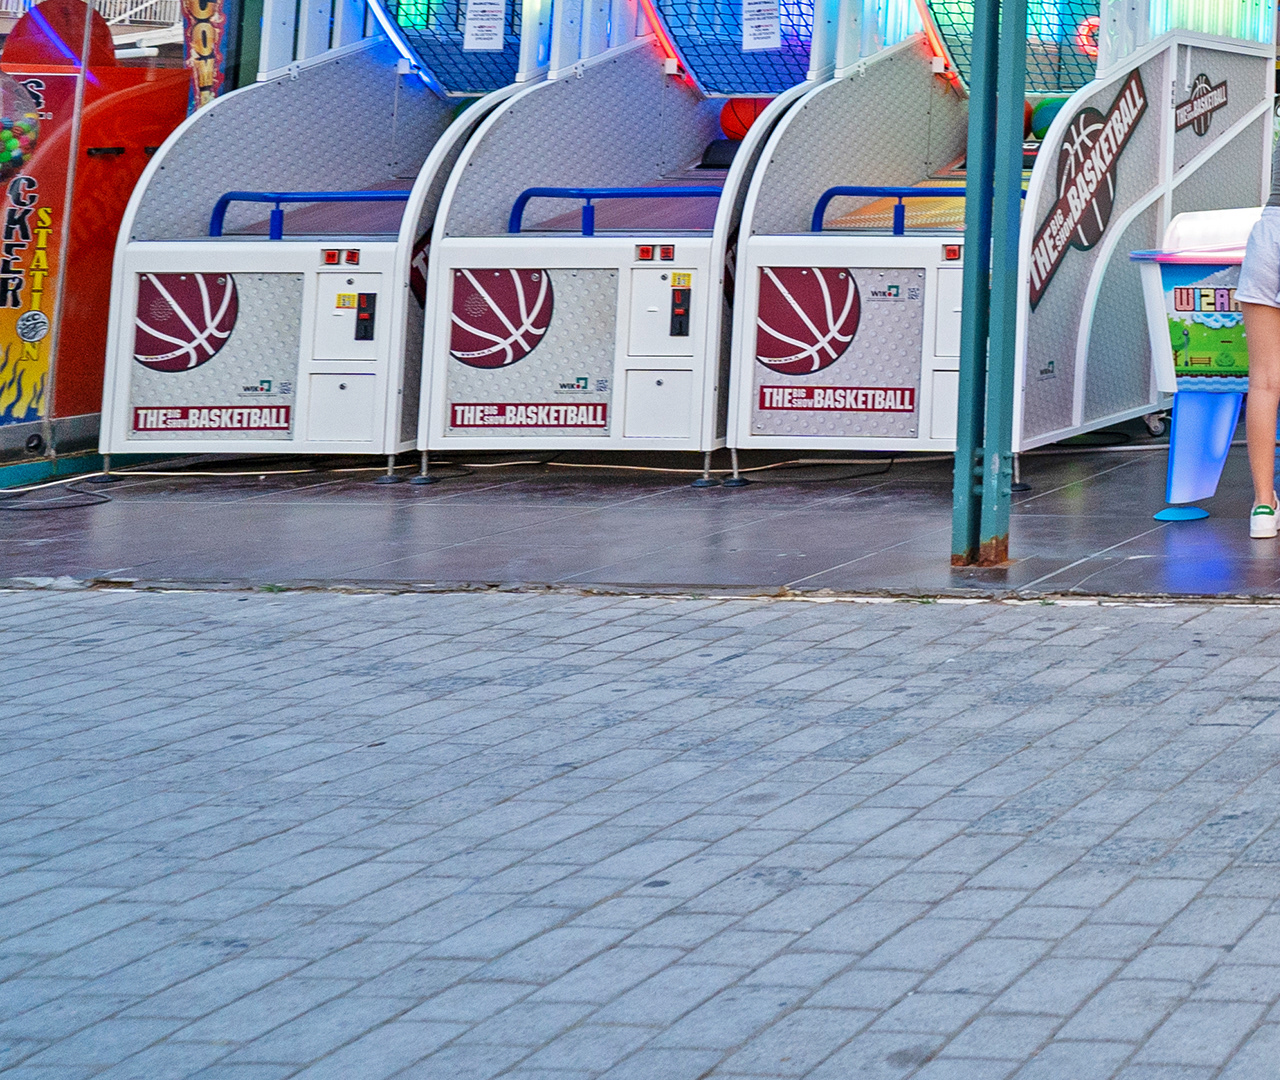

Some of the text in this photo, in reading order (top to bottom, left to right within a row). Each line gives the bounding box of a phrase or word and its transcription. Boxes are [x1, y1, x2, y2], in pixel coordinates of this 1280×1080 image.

[1029, 79, 1145, 291] THE BIG SHOW BASKETBALL
[763, 388, 793, 407] THE
[813, 389, 913, 410] BASKETBALL
[137, 409, 167, 429] THE
[188, 408, 288, 429] BASKETBALL
[454, 406, 484, 425] THE
[505, 406, 605, 425] BASKETBALL
